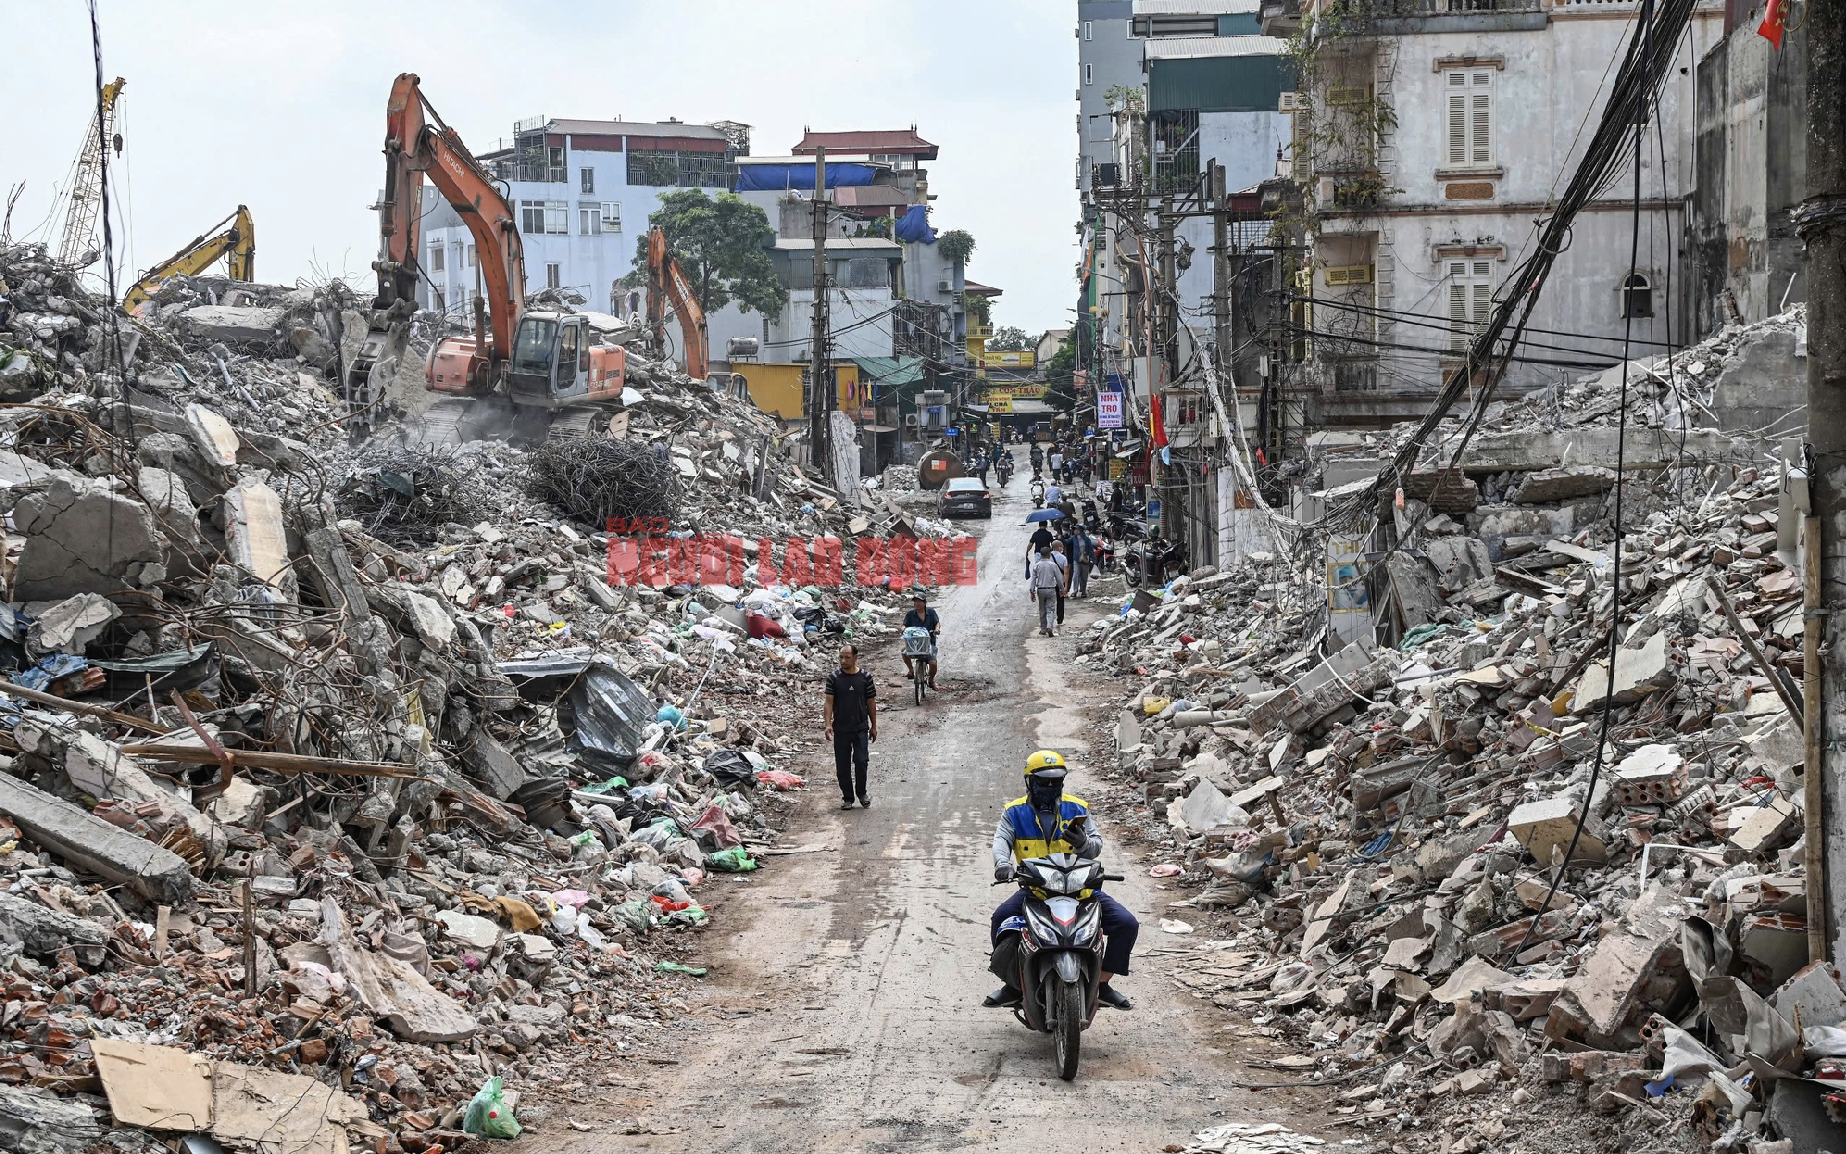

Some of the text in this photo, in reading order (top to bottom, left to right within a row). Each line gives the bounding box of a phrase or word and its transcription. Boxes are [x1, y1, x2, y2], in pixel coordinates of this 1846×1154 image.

[443, 151, 465, 178] HITACHI
[1101, 393, 1118, 402] NHÀ
[1101, 404, 1117, 414] TRỌ
